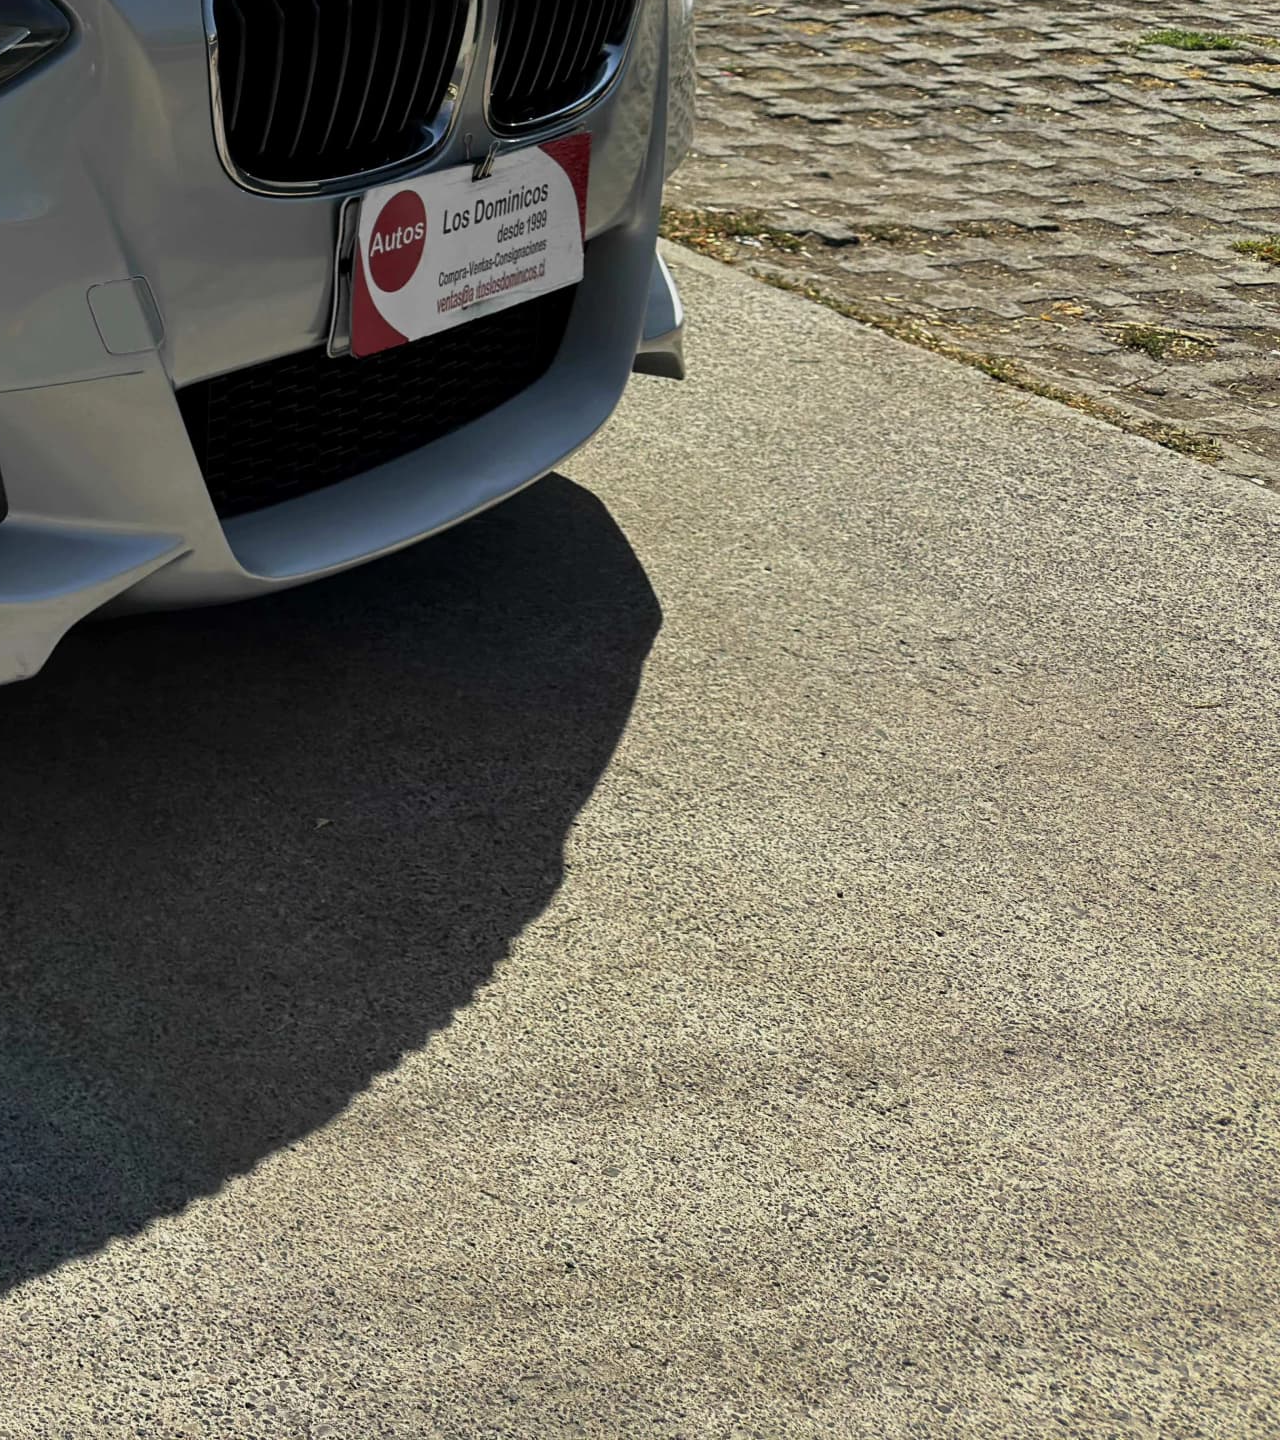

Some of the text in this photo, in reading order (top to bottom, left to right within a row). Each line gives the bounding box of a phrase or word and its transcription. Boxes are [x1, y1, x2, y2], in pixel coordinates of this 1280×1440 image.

[443, 183, 549, 234] Los Dominicos
[370, 221, 425, 257] Autos
[497, 210, 547, 244] desde 1999
